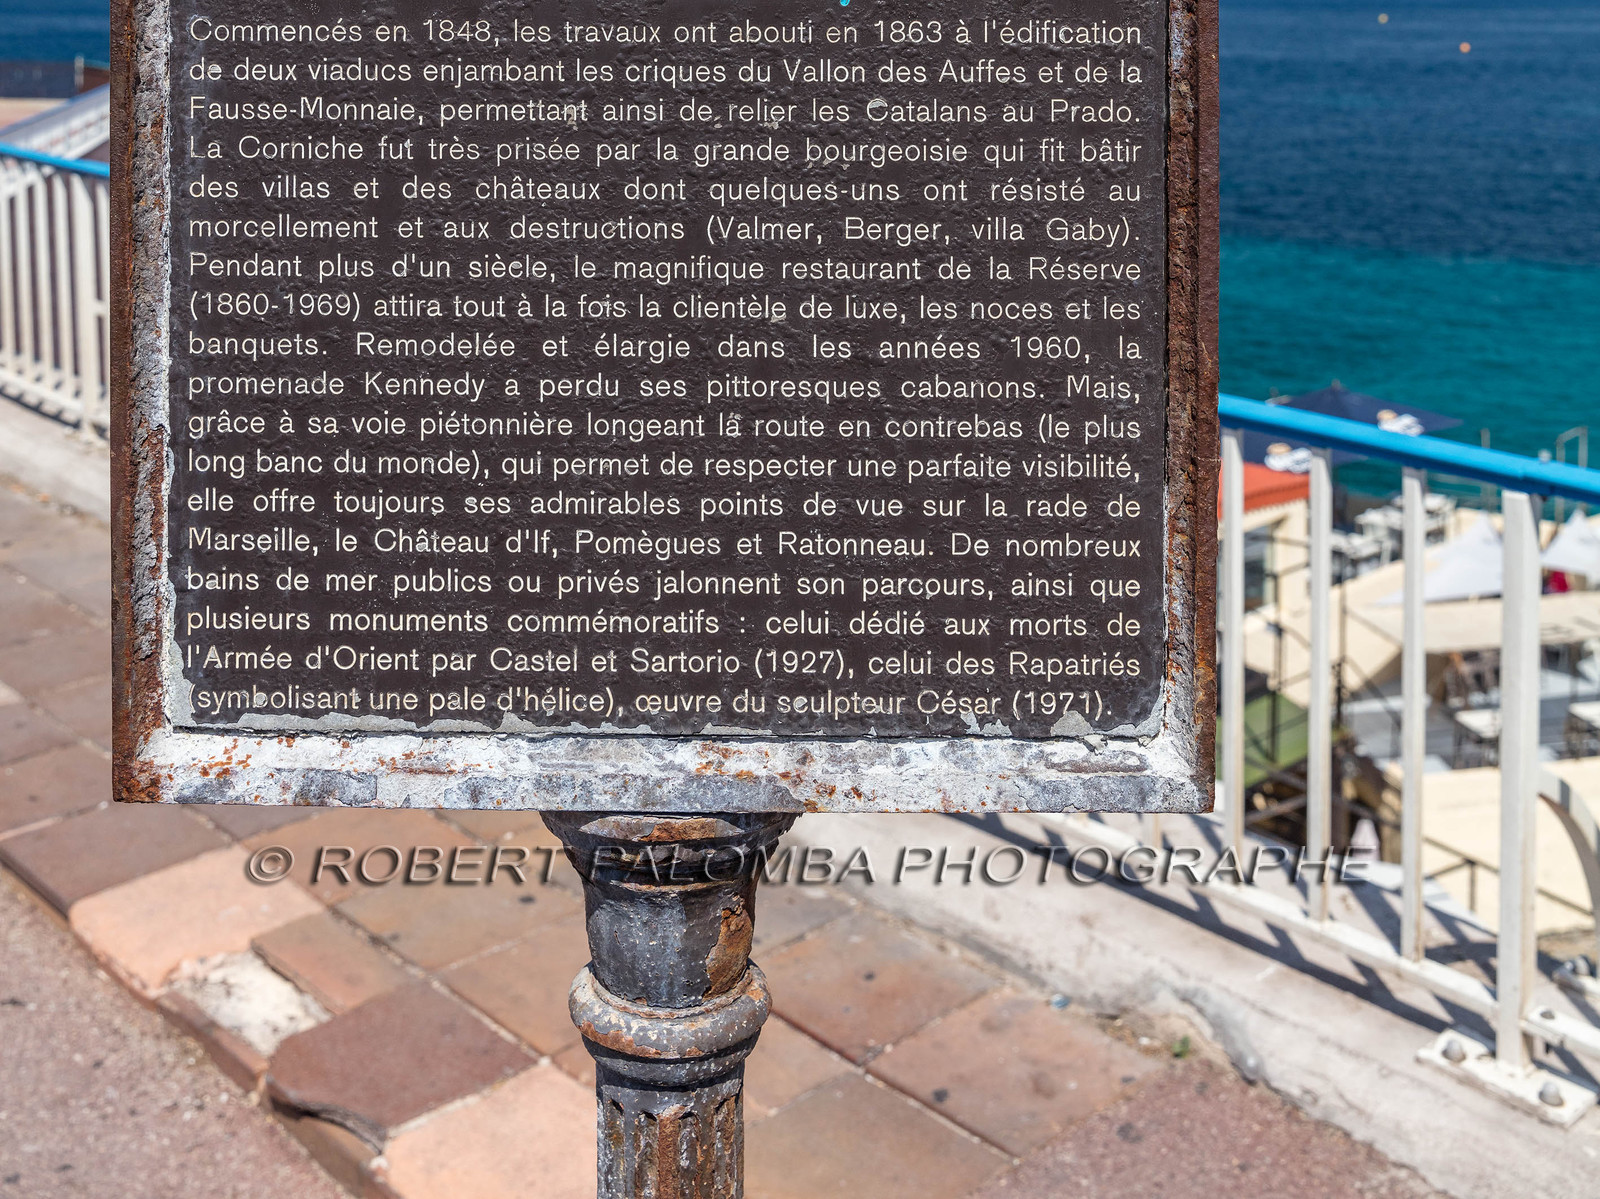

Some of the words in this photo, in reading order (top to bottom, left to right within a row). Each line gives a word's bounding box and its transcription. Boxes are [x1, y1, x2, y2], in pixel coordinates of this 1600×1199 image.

[190, 18, 363, 42] Commencés
[375, 25, 407, 42] en
[422, 19, 500, 47] 1848,
[514, 19, 552, 42] les
[563, 22, 661, 43] travaux
[674, 22, 717, 43] ont
[729, 20, 812, 43] abouti
[826, 26, 858, 43] en
[873, 20, 942, 43] 1863
[955, 20, 973, 44] à
[984, 20, 1141, 44] l'édification
[189, 57, 223, 81] de
[233, 58, 297, 81] deux
[307, 58, 412, 81] viaducs
[423, 58, 566, 89] enjambant
[576, 58, 614, 82] les
[625, 59, 727, 89] criques
[738, 59, 771, 82] du
[783, 59, 866, 82] Vallon
[878, 59, 928, 83] des
[938, 59, 1027, 83] Auffes
[1038, 62, 1064, 83] et
[1074, 60, 1108, 83] de
[1120, 60, 1143, 83] la
[189, 175, 239, 198] des
[261, 175, 331, 199] villas
[353, 178, 380, 199] et
[402, 175, 452, 199] des
[475, 176, 601, 199] châteaux
[624, 176, 687, 200] dont
[709, 177, 900, 207] quelques-uns
[923, 180, 968, 201] ont
[990, 178, 1085, 201] résisté
[1108, 185, 1141, 202] au
[189, 214, 379, 238] morcellement
[397, 217, 424, 238] et
[443, 221, 490, 238] aux
[510, 215, 685, 239] destructions
[706, 215, 822, 246] (Valmer,
[845, 217, 950, 247] Berger,
[971, 217, 1026, 240] villa
[1046, 216, 1141, 248] Gaby).
[190, 253, 303, 277] Pendant
[319, 254, 375, 284] plus
[391, 254, 451, 278] d'un
[468, 254, 555, 283] siècle,
[574, 255, 597, 278] le
[614, 255, 764, 286] magnifique
[782, 259, 922, 280] restaurant
[938, 257, 972, 280] de
[989, 257, 1012, 280] la
[1029, 257, 1141, 281] Réserve
[189, 332, 327, 362] banquets.
[356, 333, 515, 356] Remodelée
[542, 336, 569, 357] et
[594, 334, 691, 364] élargie
[717, 334, 785, 358] dans
[813, 335, 852, 358] les
[879, 335, 981, 359] années
[1010, 336, 1090, 364] 1960,
[1119, 336, 1140, 360] la
[188, 371, 345, 401] promenade
[365, 372, 486, 402] Kennedy
[504, 379, 521, 396] a
[539, 372, 619, 403] perdu
[639, 379, 687, 396] ses
[707, 374, 881, 404] pittoresques
[900, 375, 1045, 398] cabanons.
[1067, 375, 1140, 404] Mais,
[188, 410, 266, 440] grâce
[279, 410, 296, 434] à
[307, 417, 340, 434] sa
[351, 411, 406, 434] voie
[420, 411, 573, 442] piétonnière
[587, 412, 706, 443] longeant
[719, 413, 744, 436] la
[754, 416, 825, 437] route
[838, 420, 871, 437] en
[884, 414, 1023, 438] contrebas
[1038, 414, 1070, 444] (le
[1084, 415, 1141, 446] plus
[188, 449, 245, 479] long
[256, 449, 323, 473] banc
[333, 450, 366, 473] du
[378, 449, 489, 480] monde),
[501, 451, 542, 481] qui
[553, 454, 650, 482] permet
[660, 452, 694, 475] de
[704, 455, 837, 483] respecter
[848, 460, 897, 477] une
[908, 454, 1011, 484] parfaite
[1021, 455, 1140, 483] visibilité,
[187, 488, 234, 512] elle
[253, 489, 316, 512] offre
[333, 489, 445, 520] toujours
[463, 496, 511, 513] ses
[530, 491, 681, 514] admirables
[700, 492, 784, 522] points
[803, 492, 837, 516] de
[855, 499, 904, 516] vue
[922, 500, 966, 517] sur
[985, 494, 1007, 517] la
[1026, 494, 1088, 518] rade
[1106, 495, 1141, 518] de
[188, 528, 318, 556] Marseille,
[335, 528, 358, 552] le
[374, 529, 489, 553] Château
[505, 530, 558, 558] d'If,
[575, 531, 721, 561] Pomègues
[736, 534, 763, 555] et
[778, 532, 934, 556] Ratonneau.
[951, 533, 990, 556] De
[1006, 534, 1141, 557] nombreux
[187, 607, 311, 637] plusieurs
[329, 610, 489, 631] monuments
[507, 609, 720, 633] commémoratifs
[765, 611, 829, 634] celui
[849, 611, 925, 635] dédié
[944, 618, 990, 635] aux
[1009, 615, 1088, 636] morts
[1107, 613, 1141, 637] de
[186, 646, 293, 669] l'Armée
[305, 647, 420, 670] d'Orient
[432, 654, 477, 678] par
[490, 648, 578, 672] Castel
[591, 651, 618, 672] et
[630, 649, 740, 673] Sartorio
[754, 649, 854, 680] (1927),
[868, 651, 932, 675] celui
[945, 652, 996, 675] des
[1009, 653, 1141, 683] Rapatriés
[187, 684, 360, 716] (symbolisant
[369, 693, 419, 710] une
[429, 687, 486, 717] pale
[496, 687, 624, 717] d'hélice),
[635, 695, 722, 712] œuvre
[732, 689, 766, 713] du
[776, 690, 907, 720] sculpteur
[917, 691, 1002, 714] César
[1012, 691, 1112, 721] (1971).
